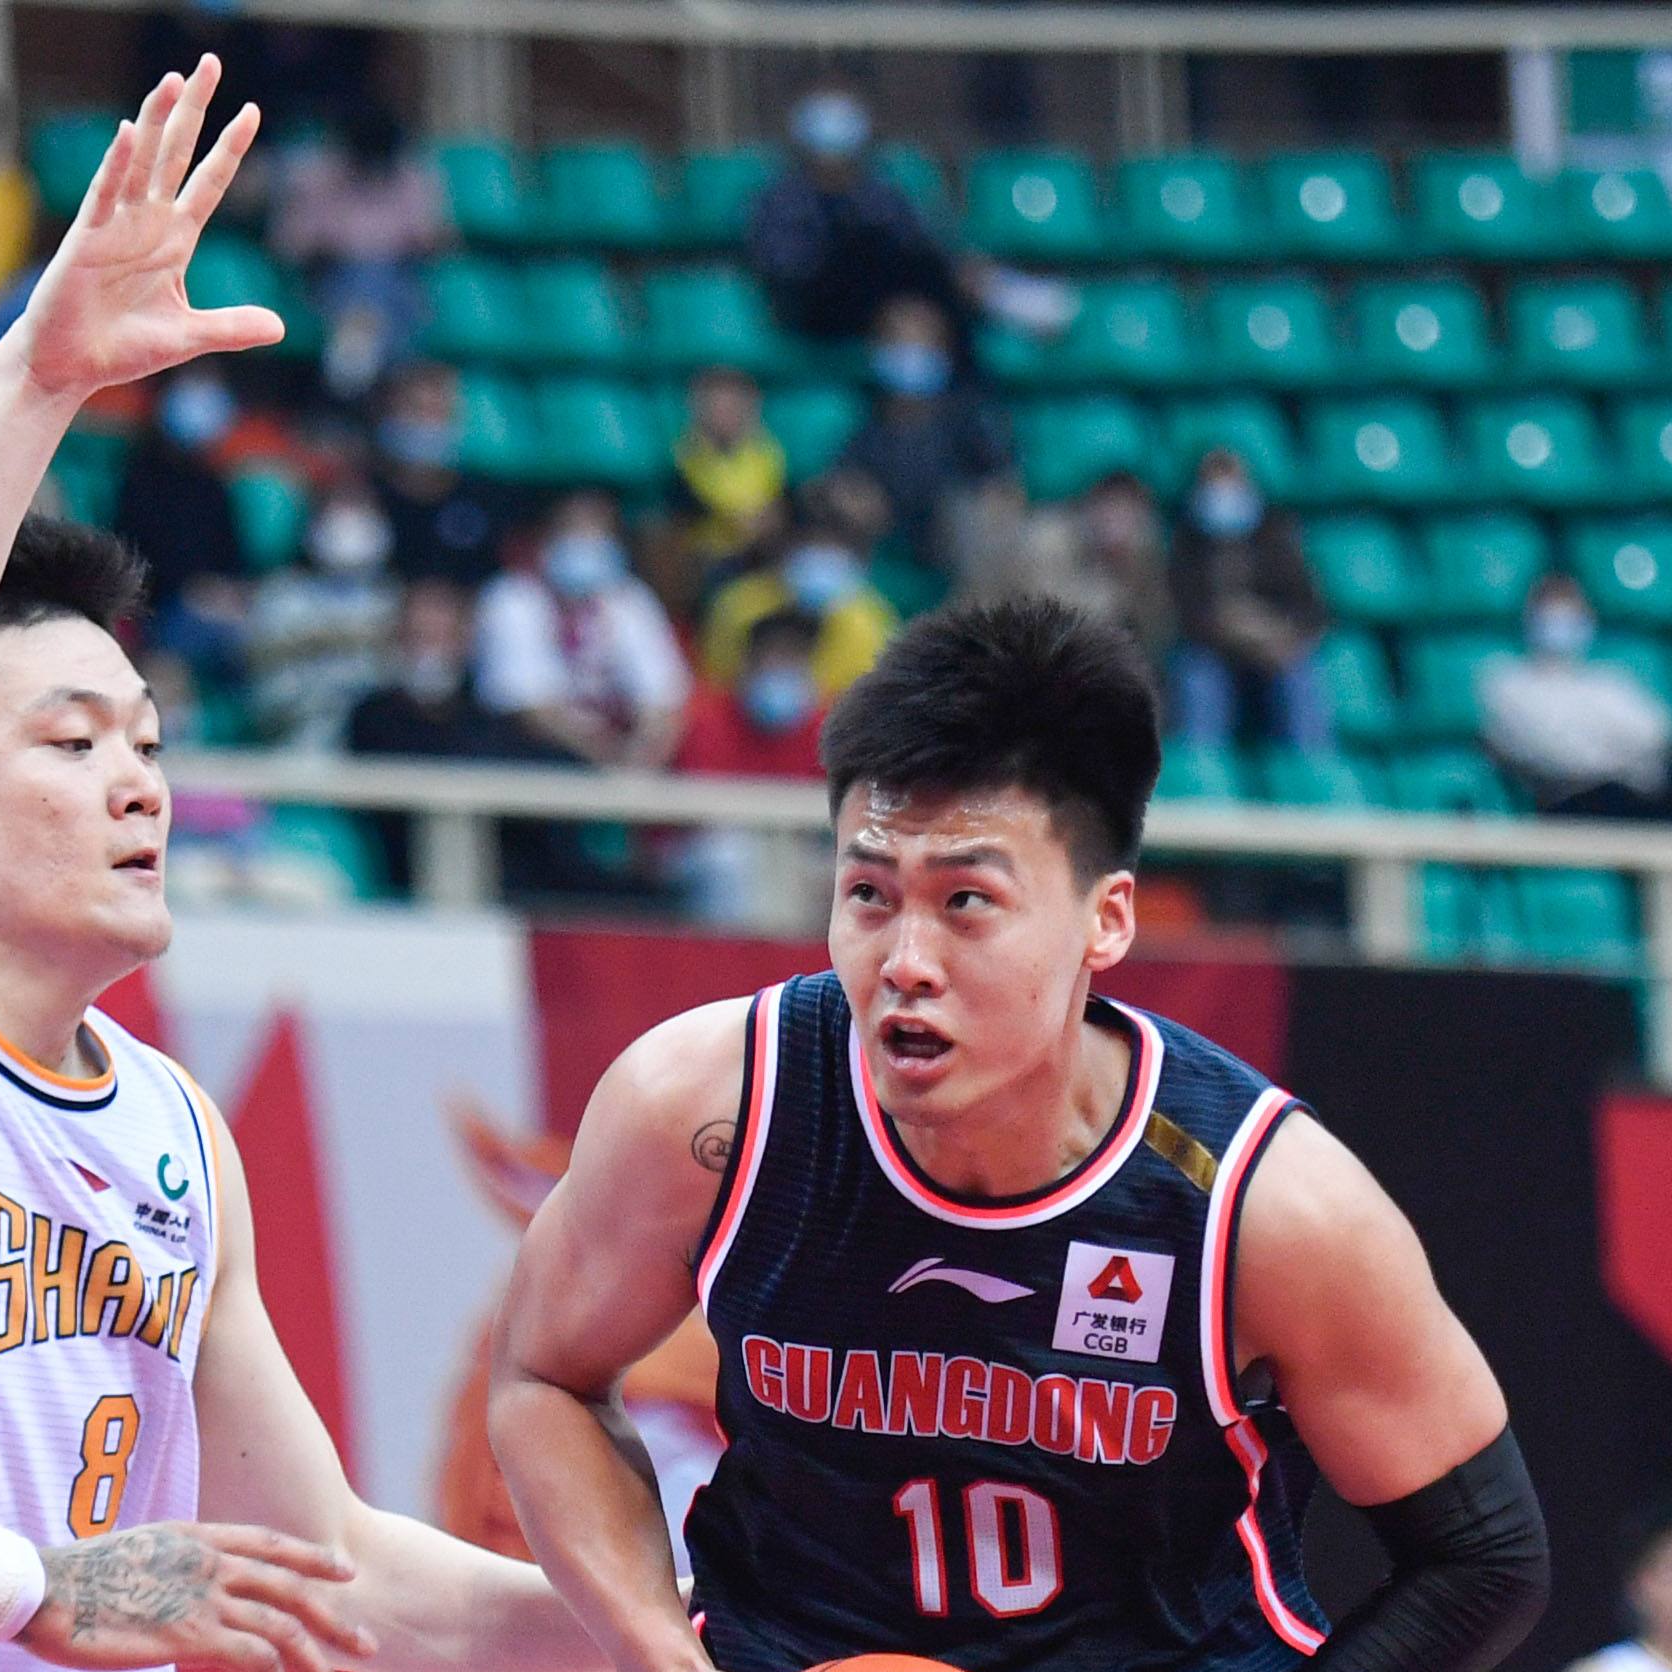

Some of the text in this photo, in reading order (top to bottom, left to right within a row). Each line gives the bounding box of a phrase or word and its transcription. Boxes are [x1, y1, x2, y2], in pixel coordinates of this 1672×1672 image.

[1071, 1310, 1148, 1337] 广发银行
[1083, 1332, 1129, 1354] CGB
[741, 1333, 1178, 1466] GUANGDONG
[66, 1393, 141, 1542] 8
[892, 1478, 1064, 1620] 10
